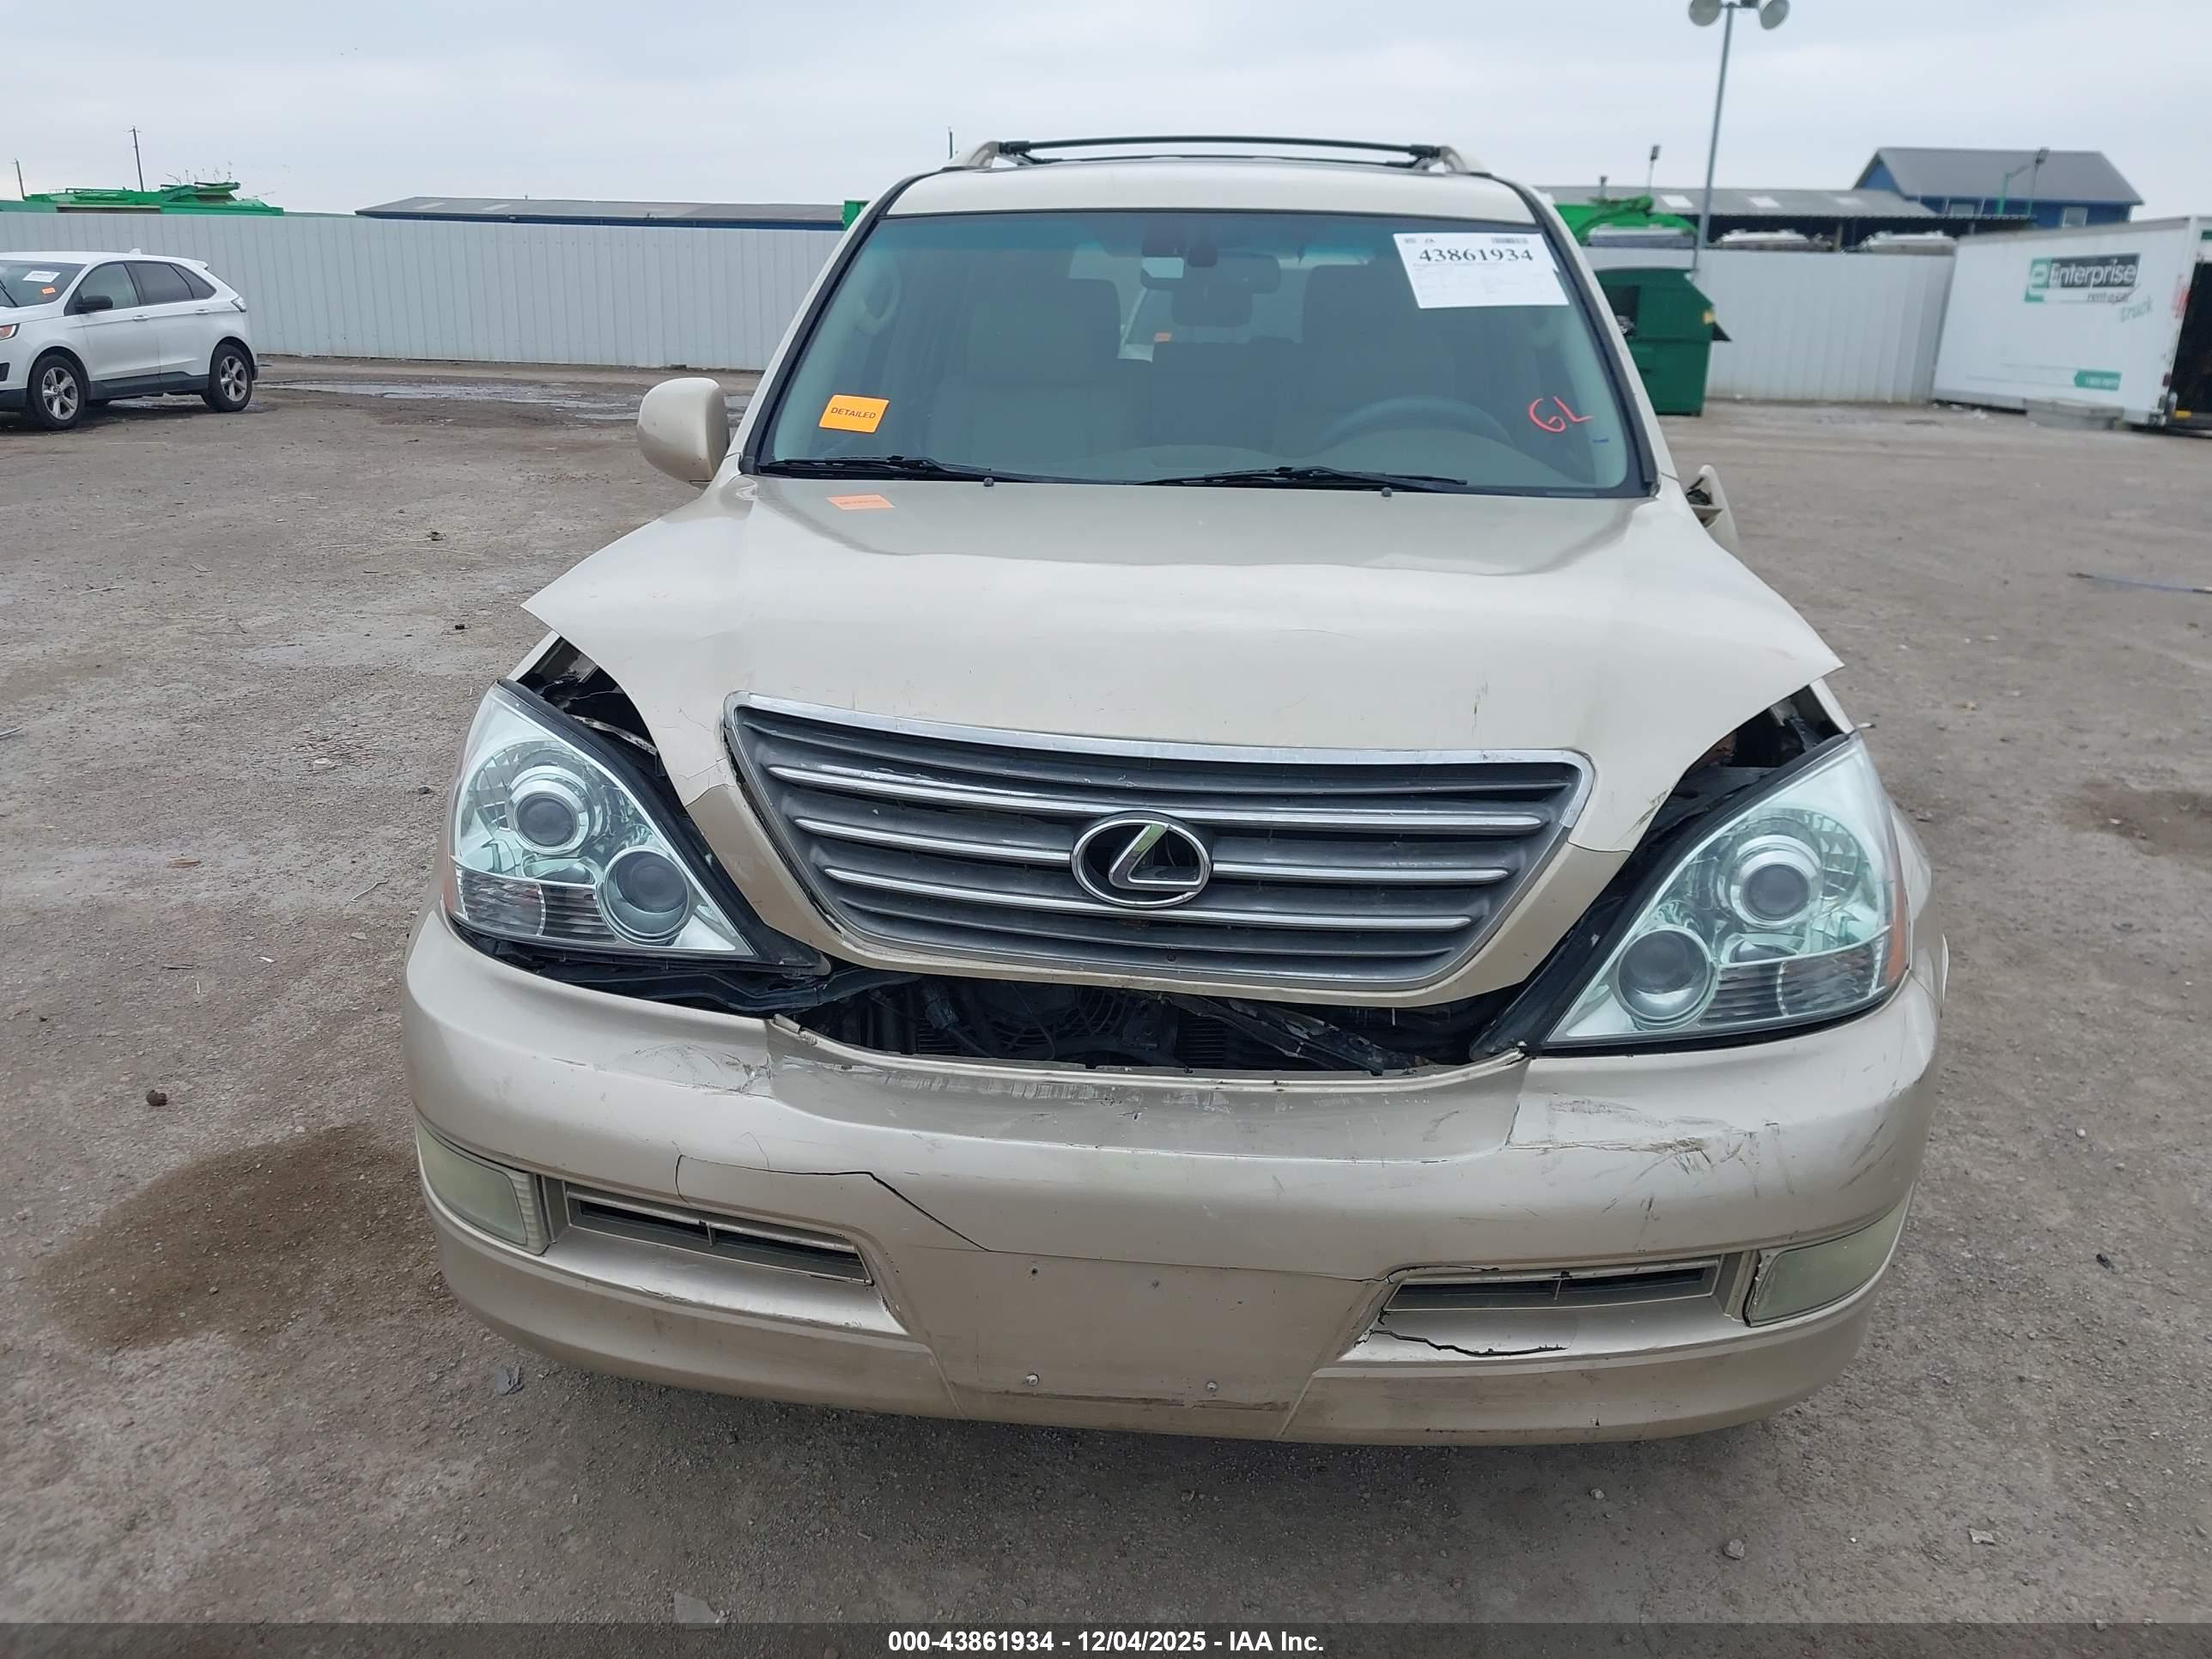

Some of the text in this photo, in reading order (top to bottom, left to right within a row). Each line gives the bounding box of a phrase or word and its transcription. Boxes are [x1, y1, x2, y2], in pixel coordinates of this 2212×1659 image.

[1419, 248, 1534, 262] 43861934
[2049, 259, 2136, 289] Enterprise
[830, 407, 877, 419] DETAILED
